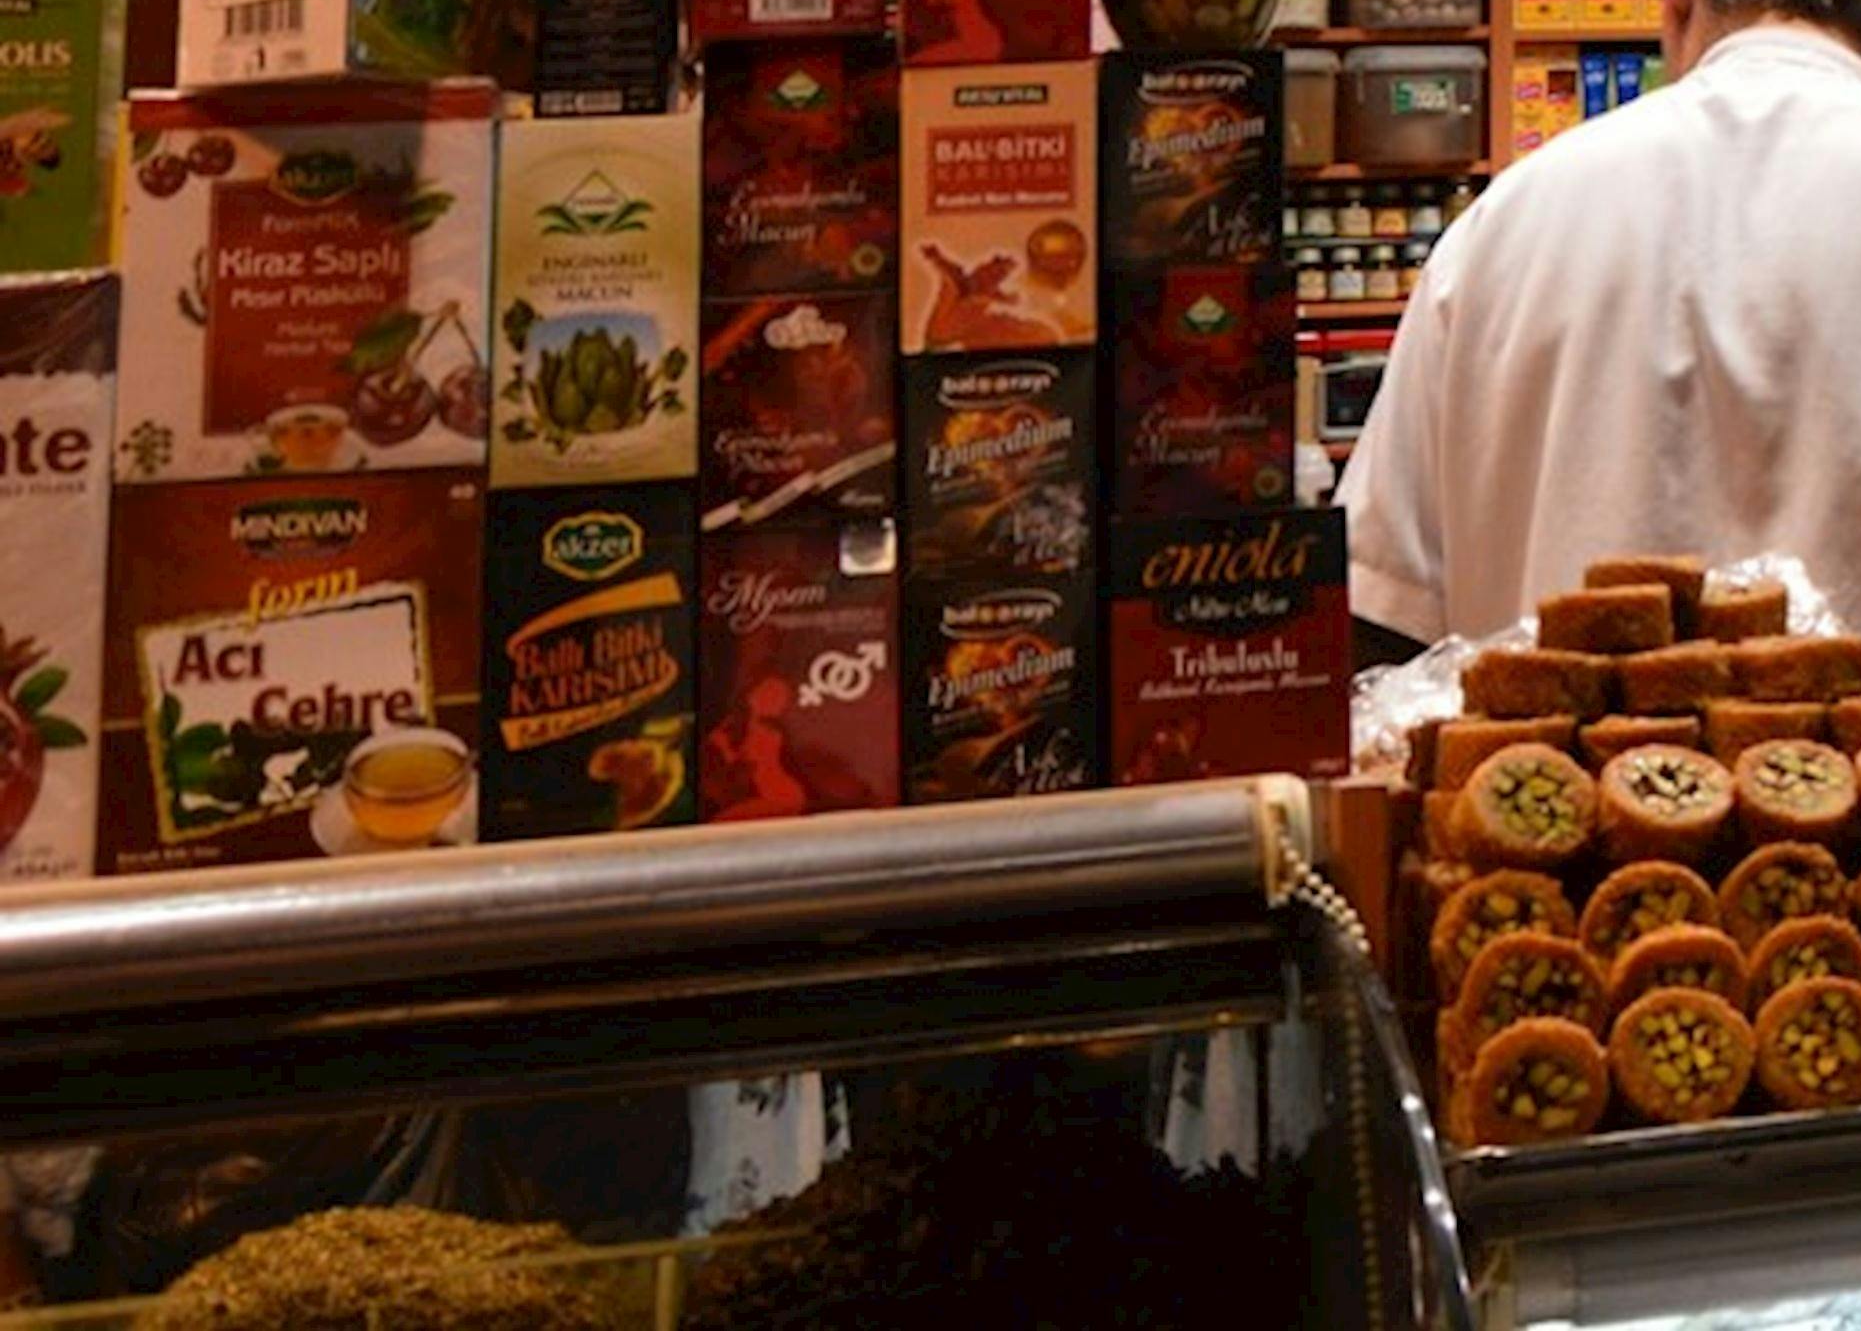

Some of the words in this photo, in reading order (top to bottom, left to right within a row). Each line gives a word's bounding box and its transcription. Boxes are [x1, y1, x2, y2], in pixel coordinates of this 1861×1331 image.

[218, 245, 306, 280] Kiraz
[311, 241, 401, 280] Saplı
[0, 416, 92, 475] te
[243, 566, 361, 629] form
[173, 636, 266, 686] Acı
[252, 681, 415, 733] Cehre
